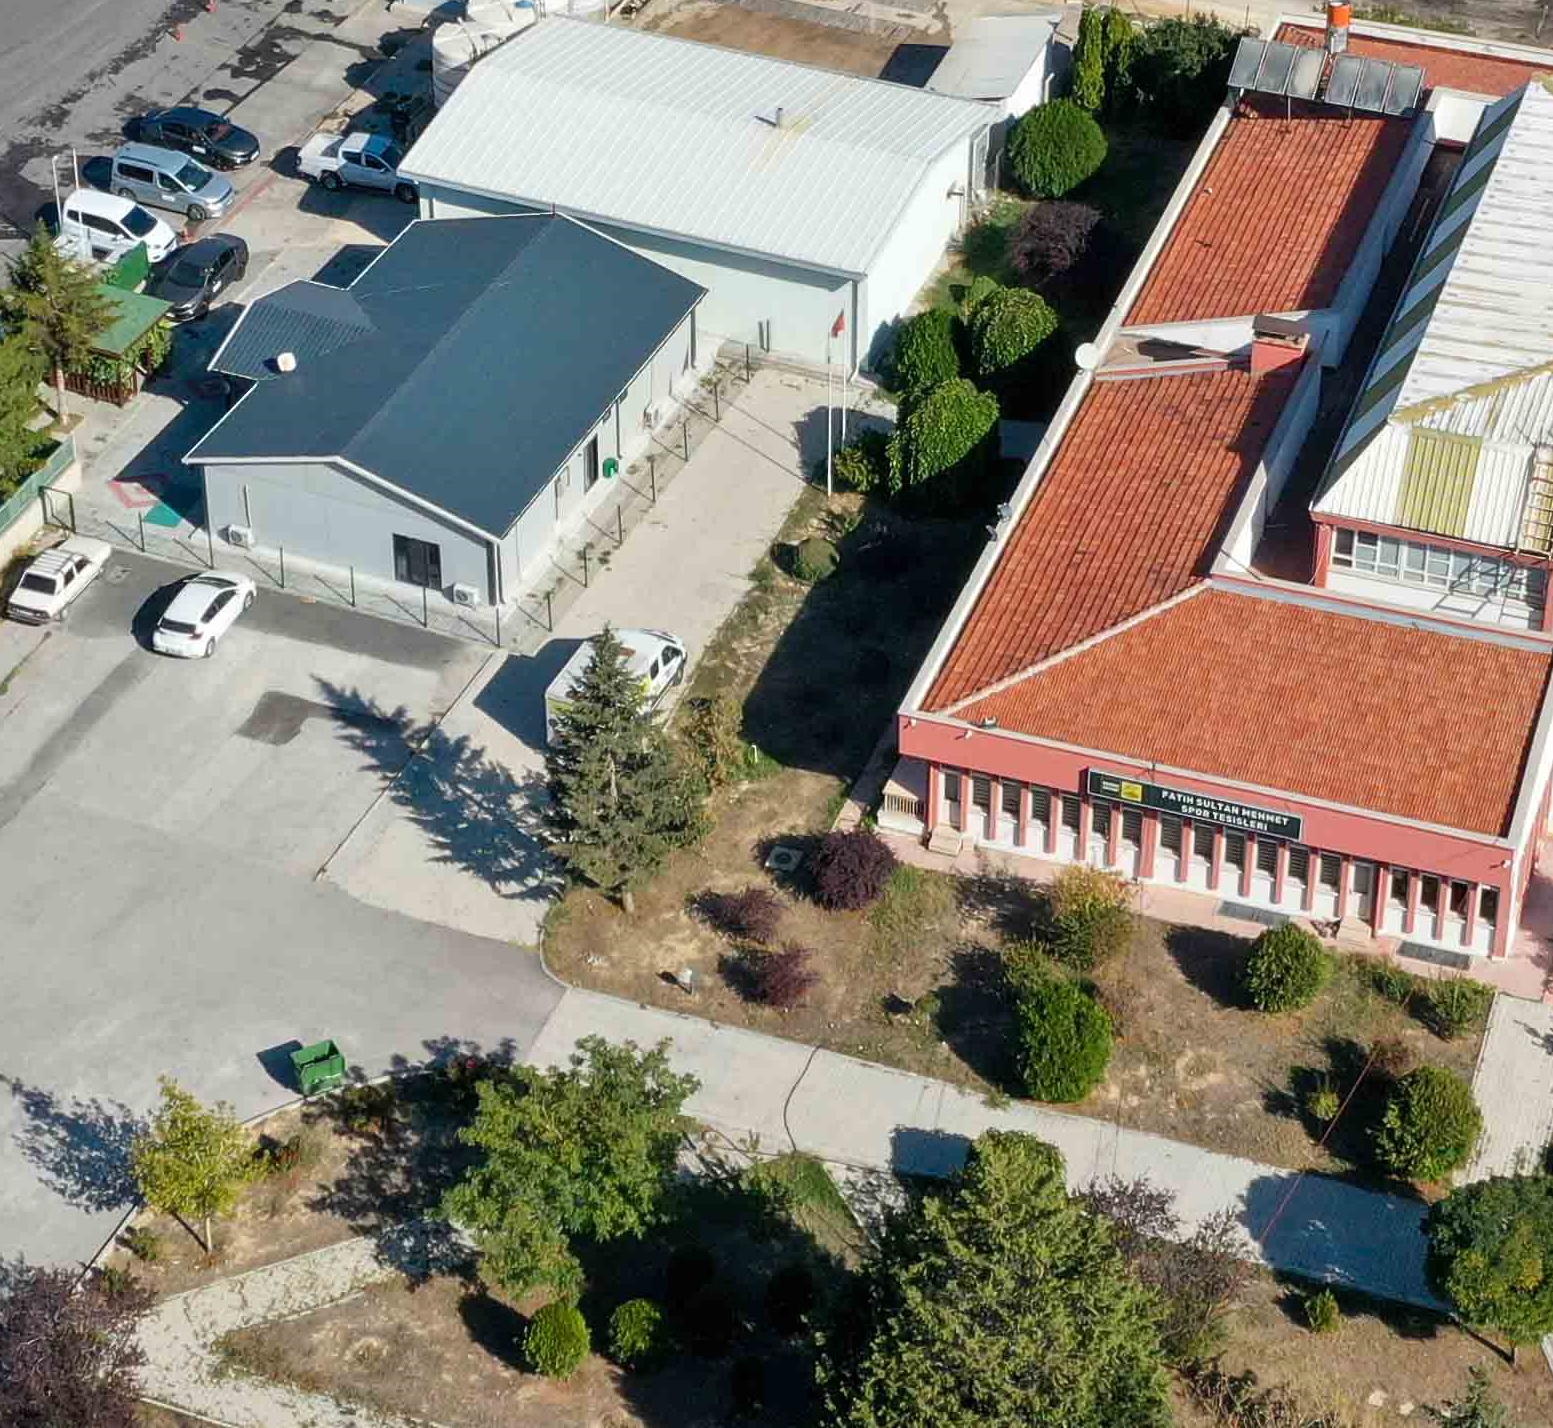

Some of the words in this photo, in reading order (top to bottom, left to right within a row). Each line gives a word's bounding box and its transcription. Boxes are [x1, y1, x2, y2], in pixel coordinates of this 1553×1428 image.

[1181, 805, 1210, 818] SPOR
[1196, 798, 1239, 815] SULTAN
[1242, 808, 1289, 826] MEHMET
